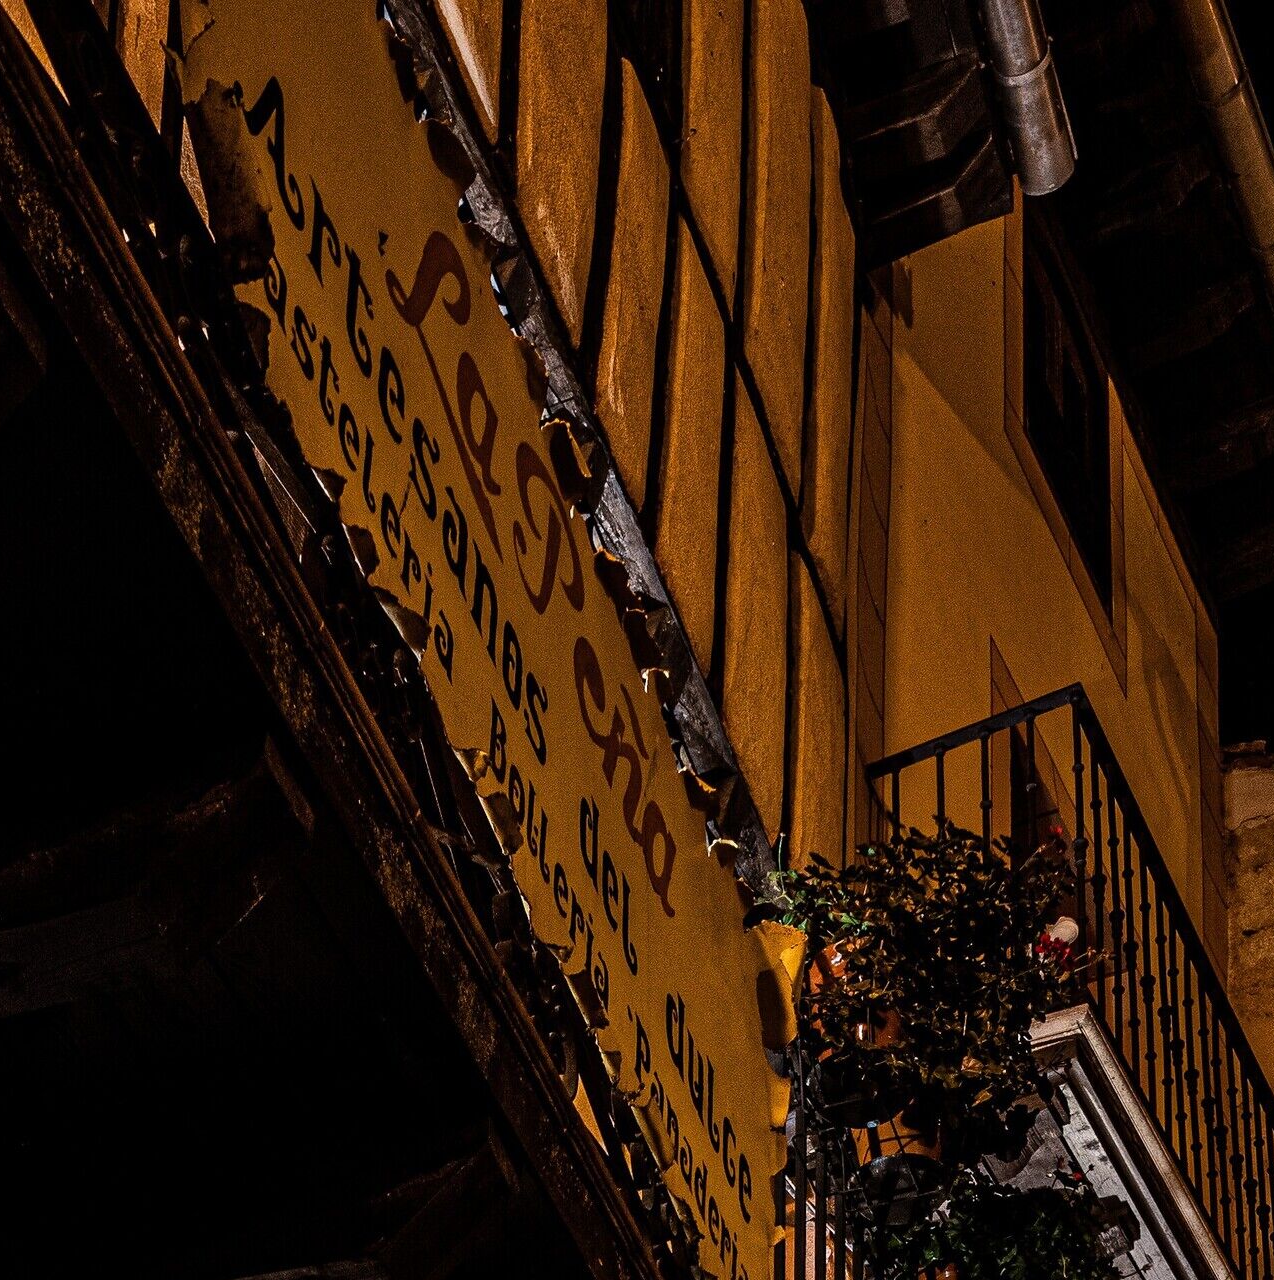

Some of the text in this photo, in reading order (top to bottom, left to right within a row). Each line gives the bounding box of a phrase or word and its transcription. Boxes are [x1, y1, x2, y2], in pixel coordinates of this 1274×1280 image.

[244, 75, 751, 1223] Artesanos del dulce
[263, 250, 453, 685] asteleria
